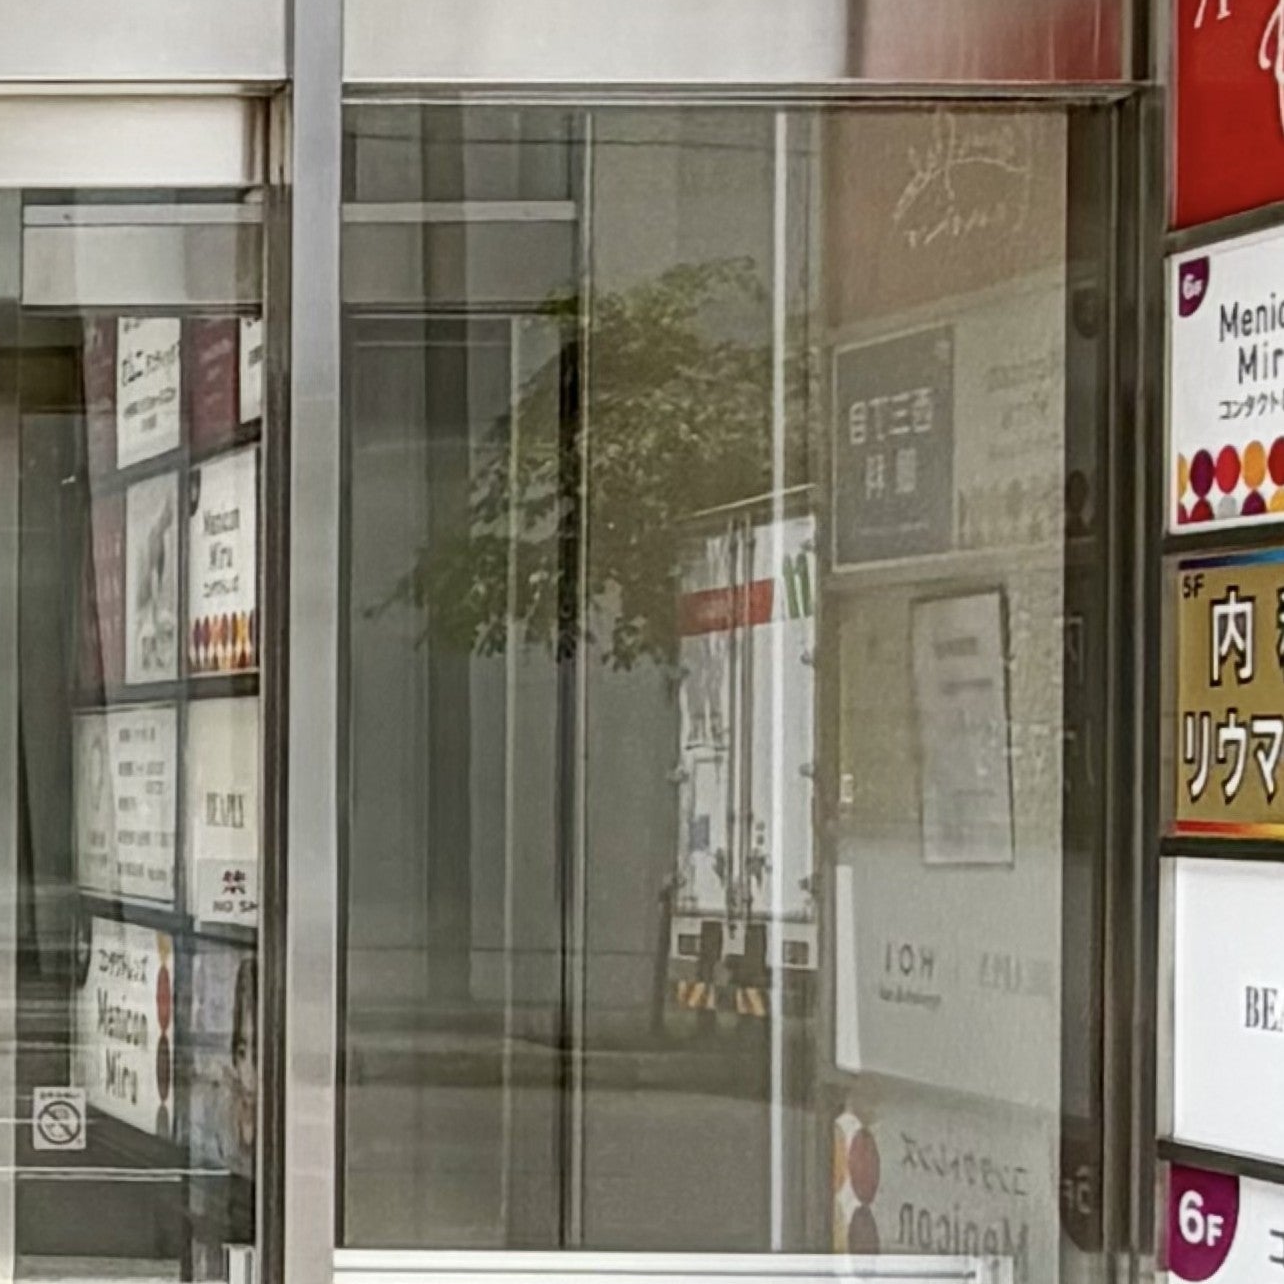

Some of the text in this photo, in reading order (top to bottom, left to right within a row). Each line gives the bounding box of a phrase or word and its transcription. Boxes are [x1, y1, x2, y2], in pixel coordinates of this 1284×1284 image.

[1219, 391, 1284, 420] コンタクト
[1210, 585, 1284, 687] 内
[1179, 1189, 1225, 1247] 6F
